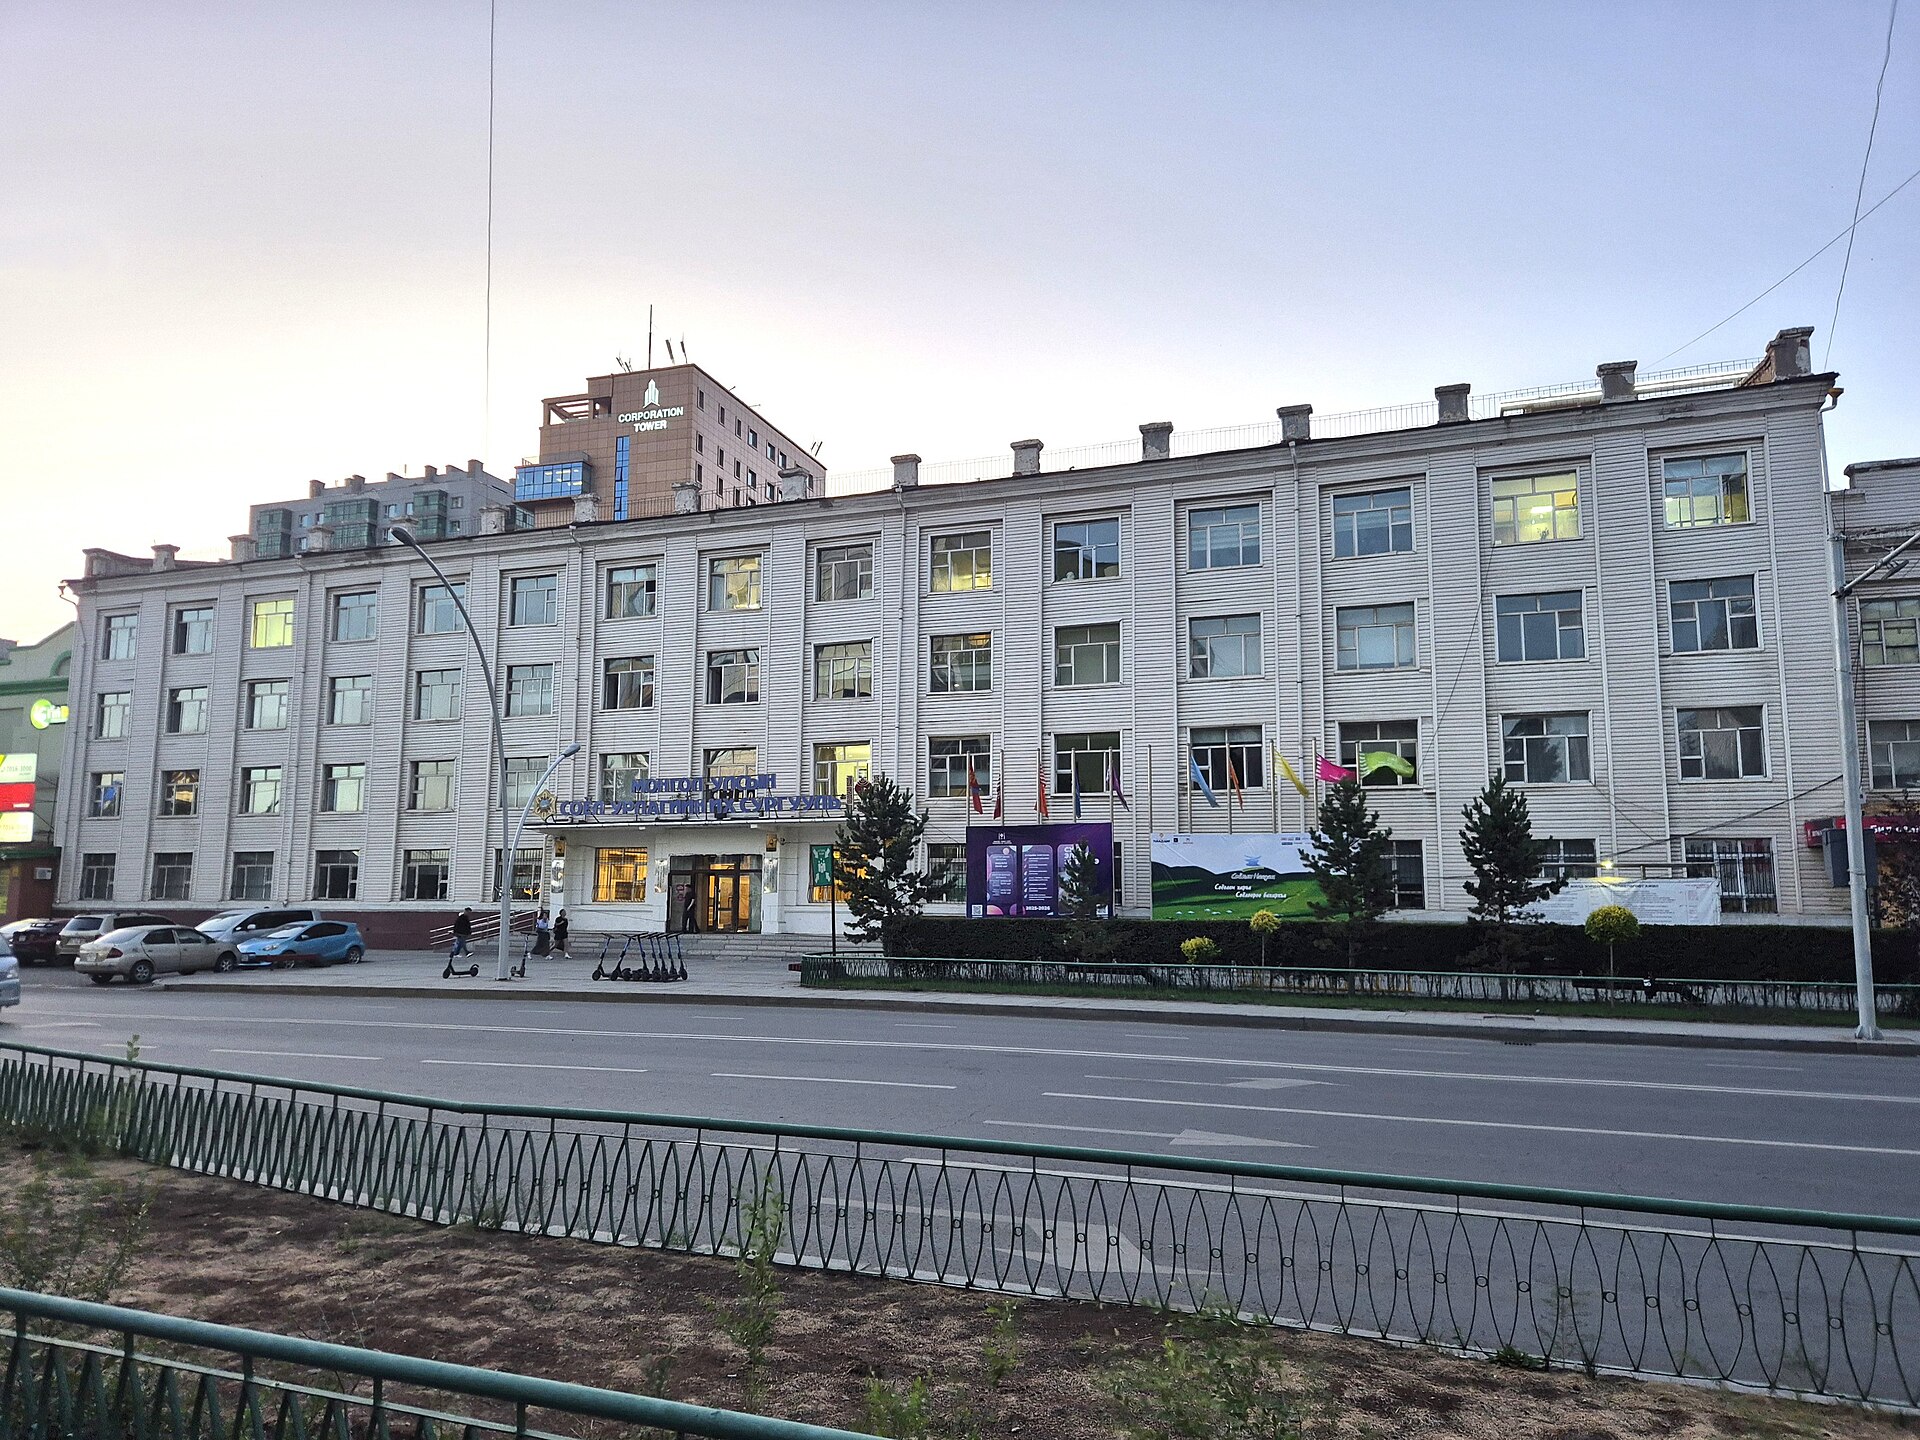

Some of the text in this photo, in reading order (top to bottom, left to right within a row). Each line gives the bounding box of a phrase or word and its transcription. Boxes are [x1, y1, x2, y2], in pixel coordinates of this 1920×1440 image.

[618, 407, 684, 423] CORPORATION
[633, 420, 667, 433] TOWER
[631, 774, 776, 793] МОНГОЛ УЛСЫН
[739, 795, 842, 813] СУРГУУЛЬ
